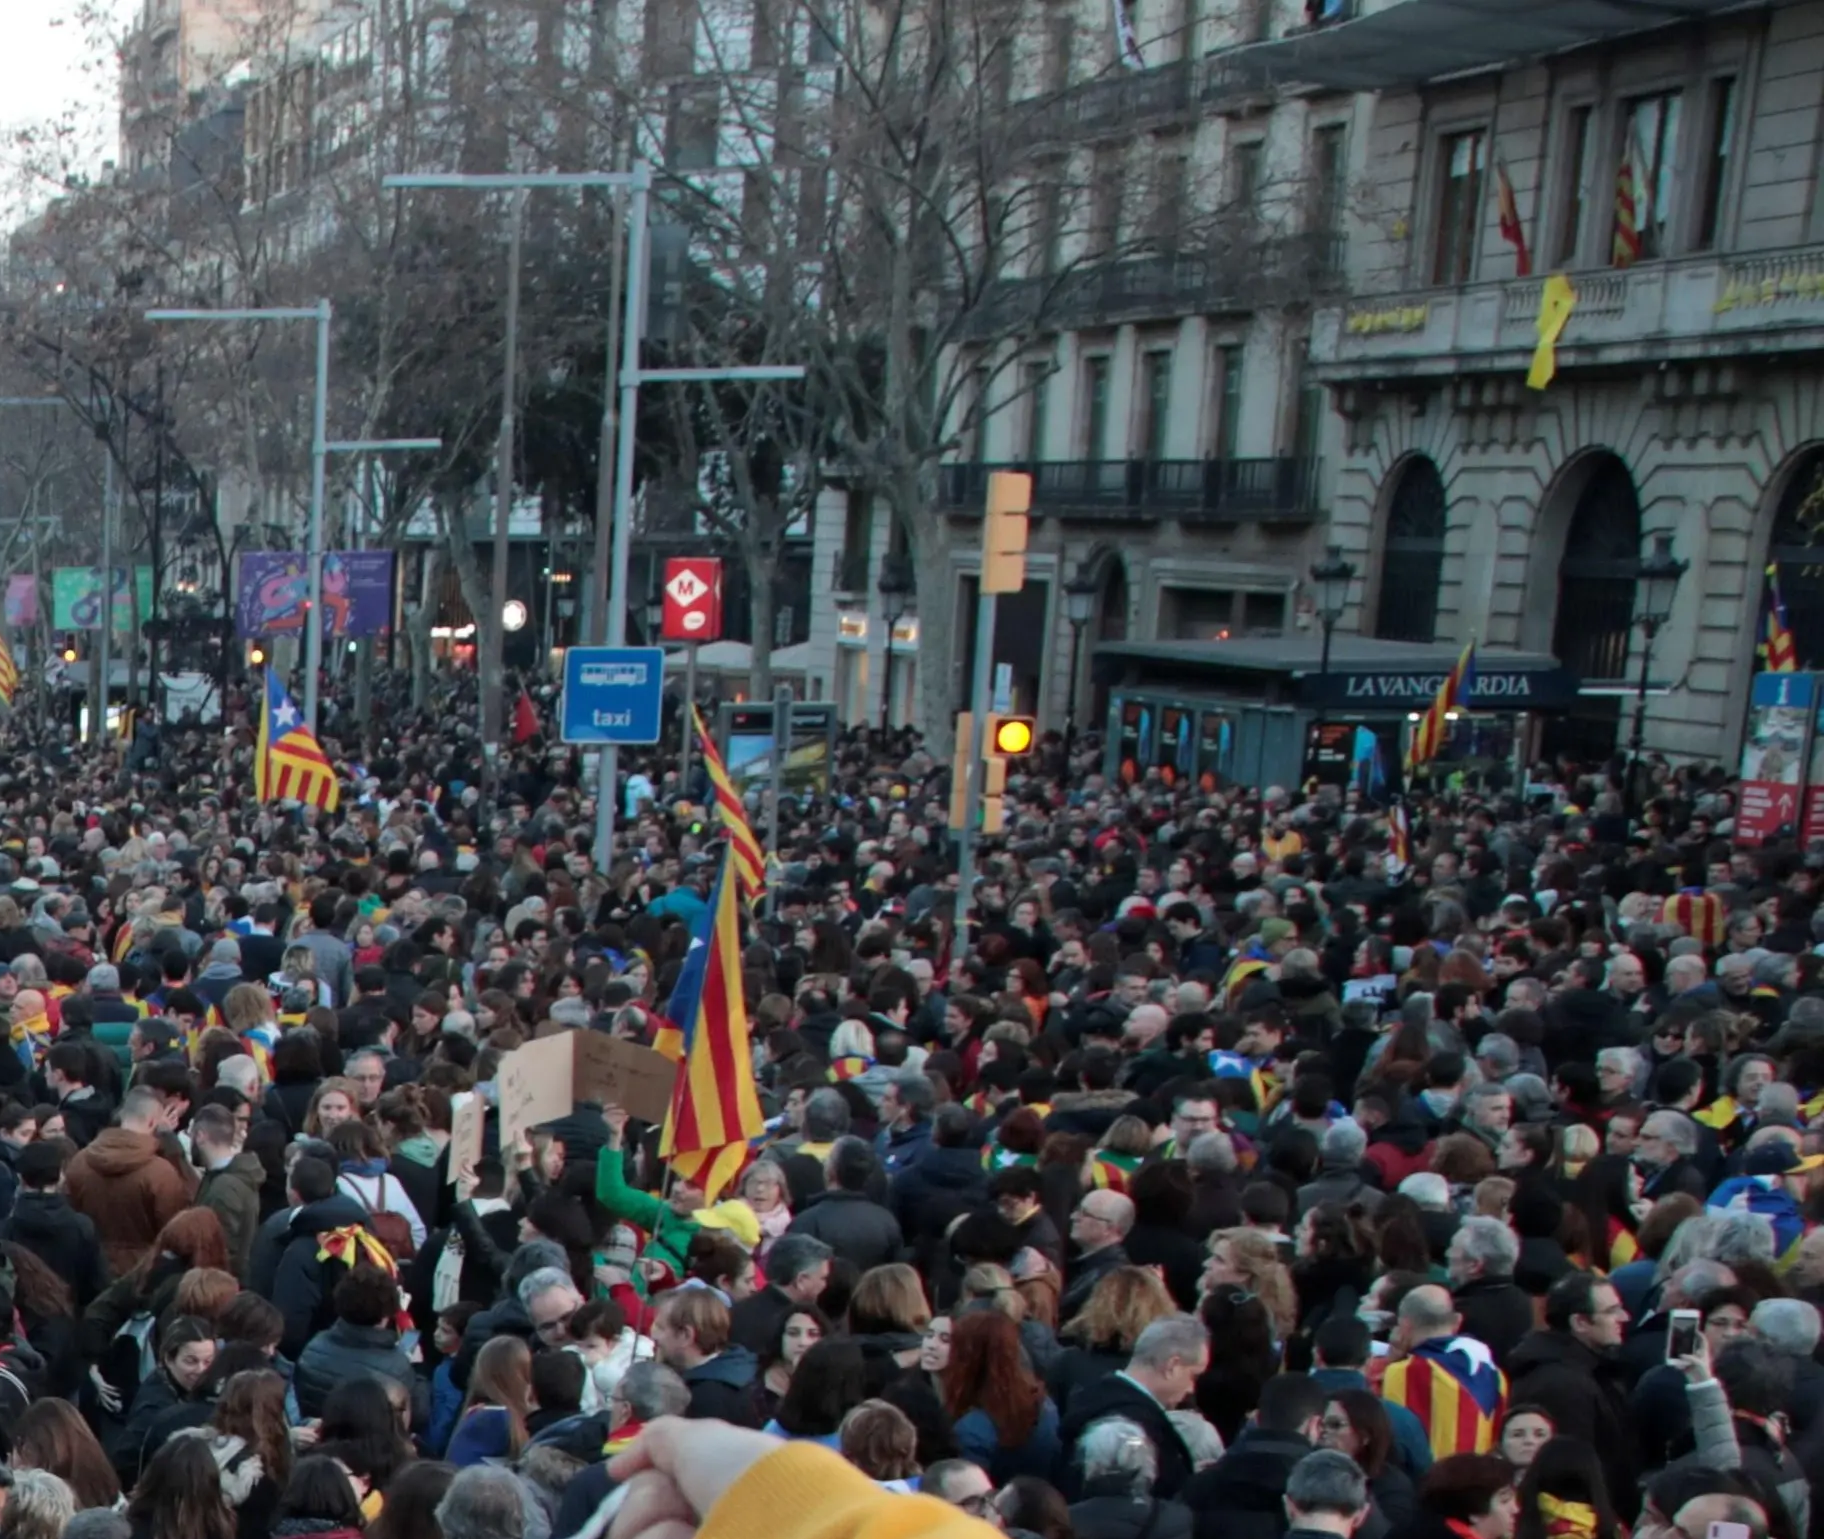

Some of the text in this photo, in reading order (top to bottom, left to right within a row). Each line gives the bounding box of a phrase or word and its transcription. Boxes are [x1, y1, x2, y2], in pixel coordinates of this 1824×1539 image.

[678, 580, 693, 596] M
[1346, 675, 1531, 696] LA VANGRDIA
[592, 709, 632, 728] taxi
